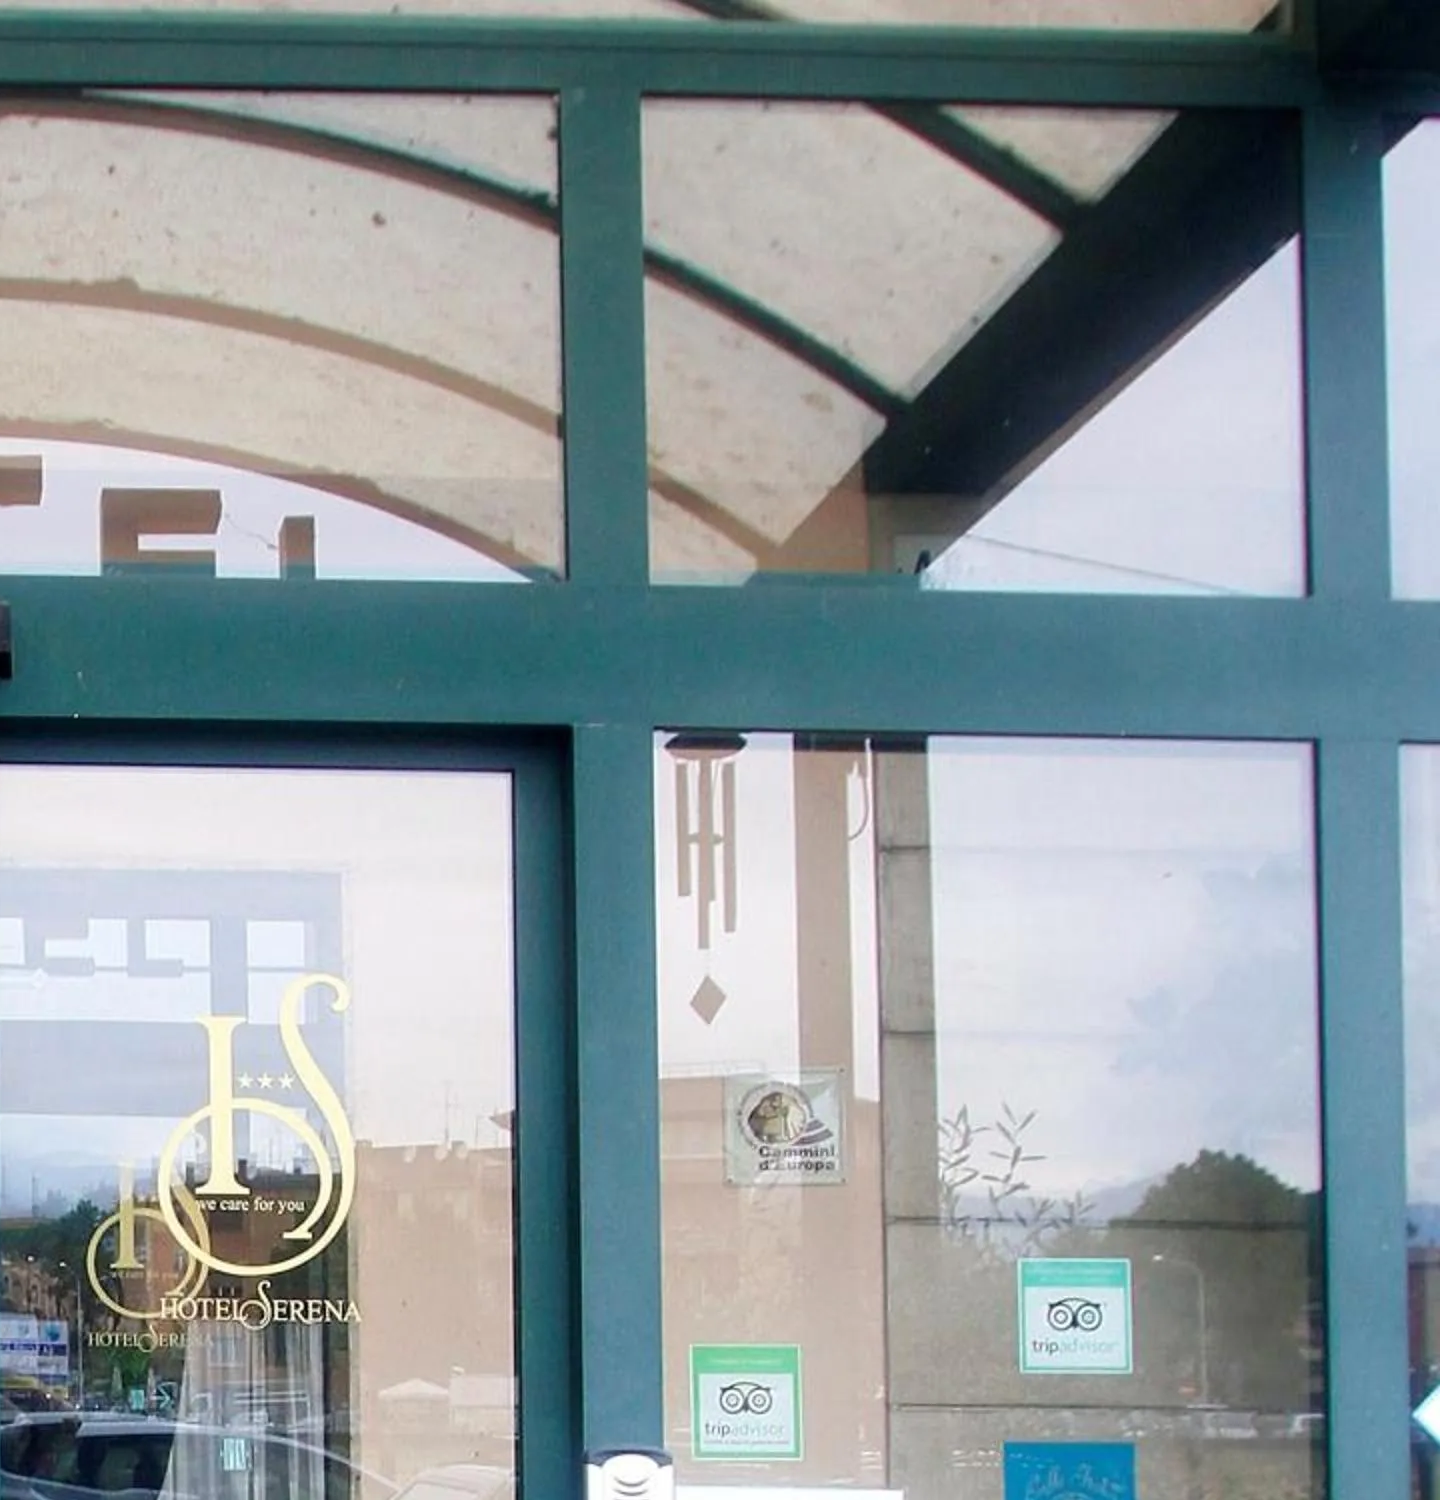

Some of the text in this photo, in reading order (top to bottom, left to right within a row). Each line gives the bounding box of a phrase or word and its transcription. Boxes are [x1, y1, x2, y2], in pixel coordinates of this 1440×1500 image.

[758, 1144, 836, 1158] Cammini
[758, 1160, 836, 1174] d'Europa
[196, 1196, 305, 1215] we care for you
[160, 1280, 364, 1331] HOTEL SERENA
[1031, 1337, 1116, 1356] tripadvisor
[704, 1421, 786, 1438] tripadvisor
